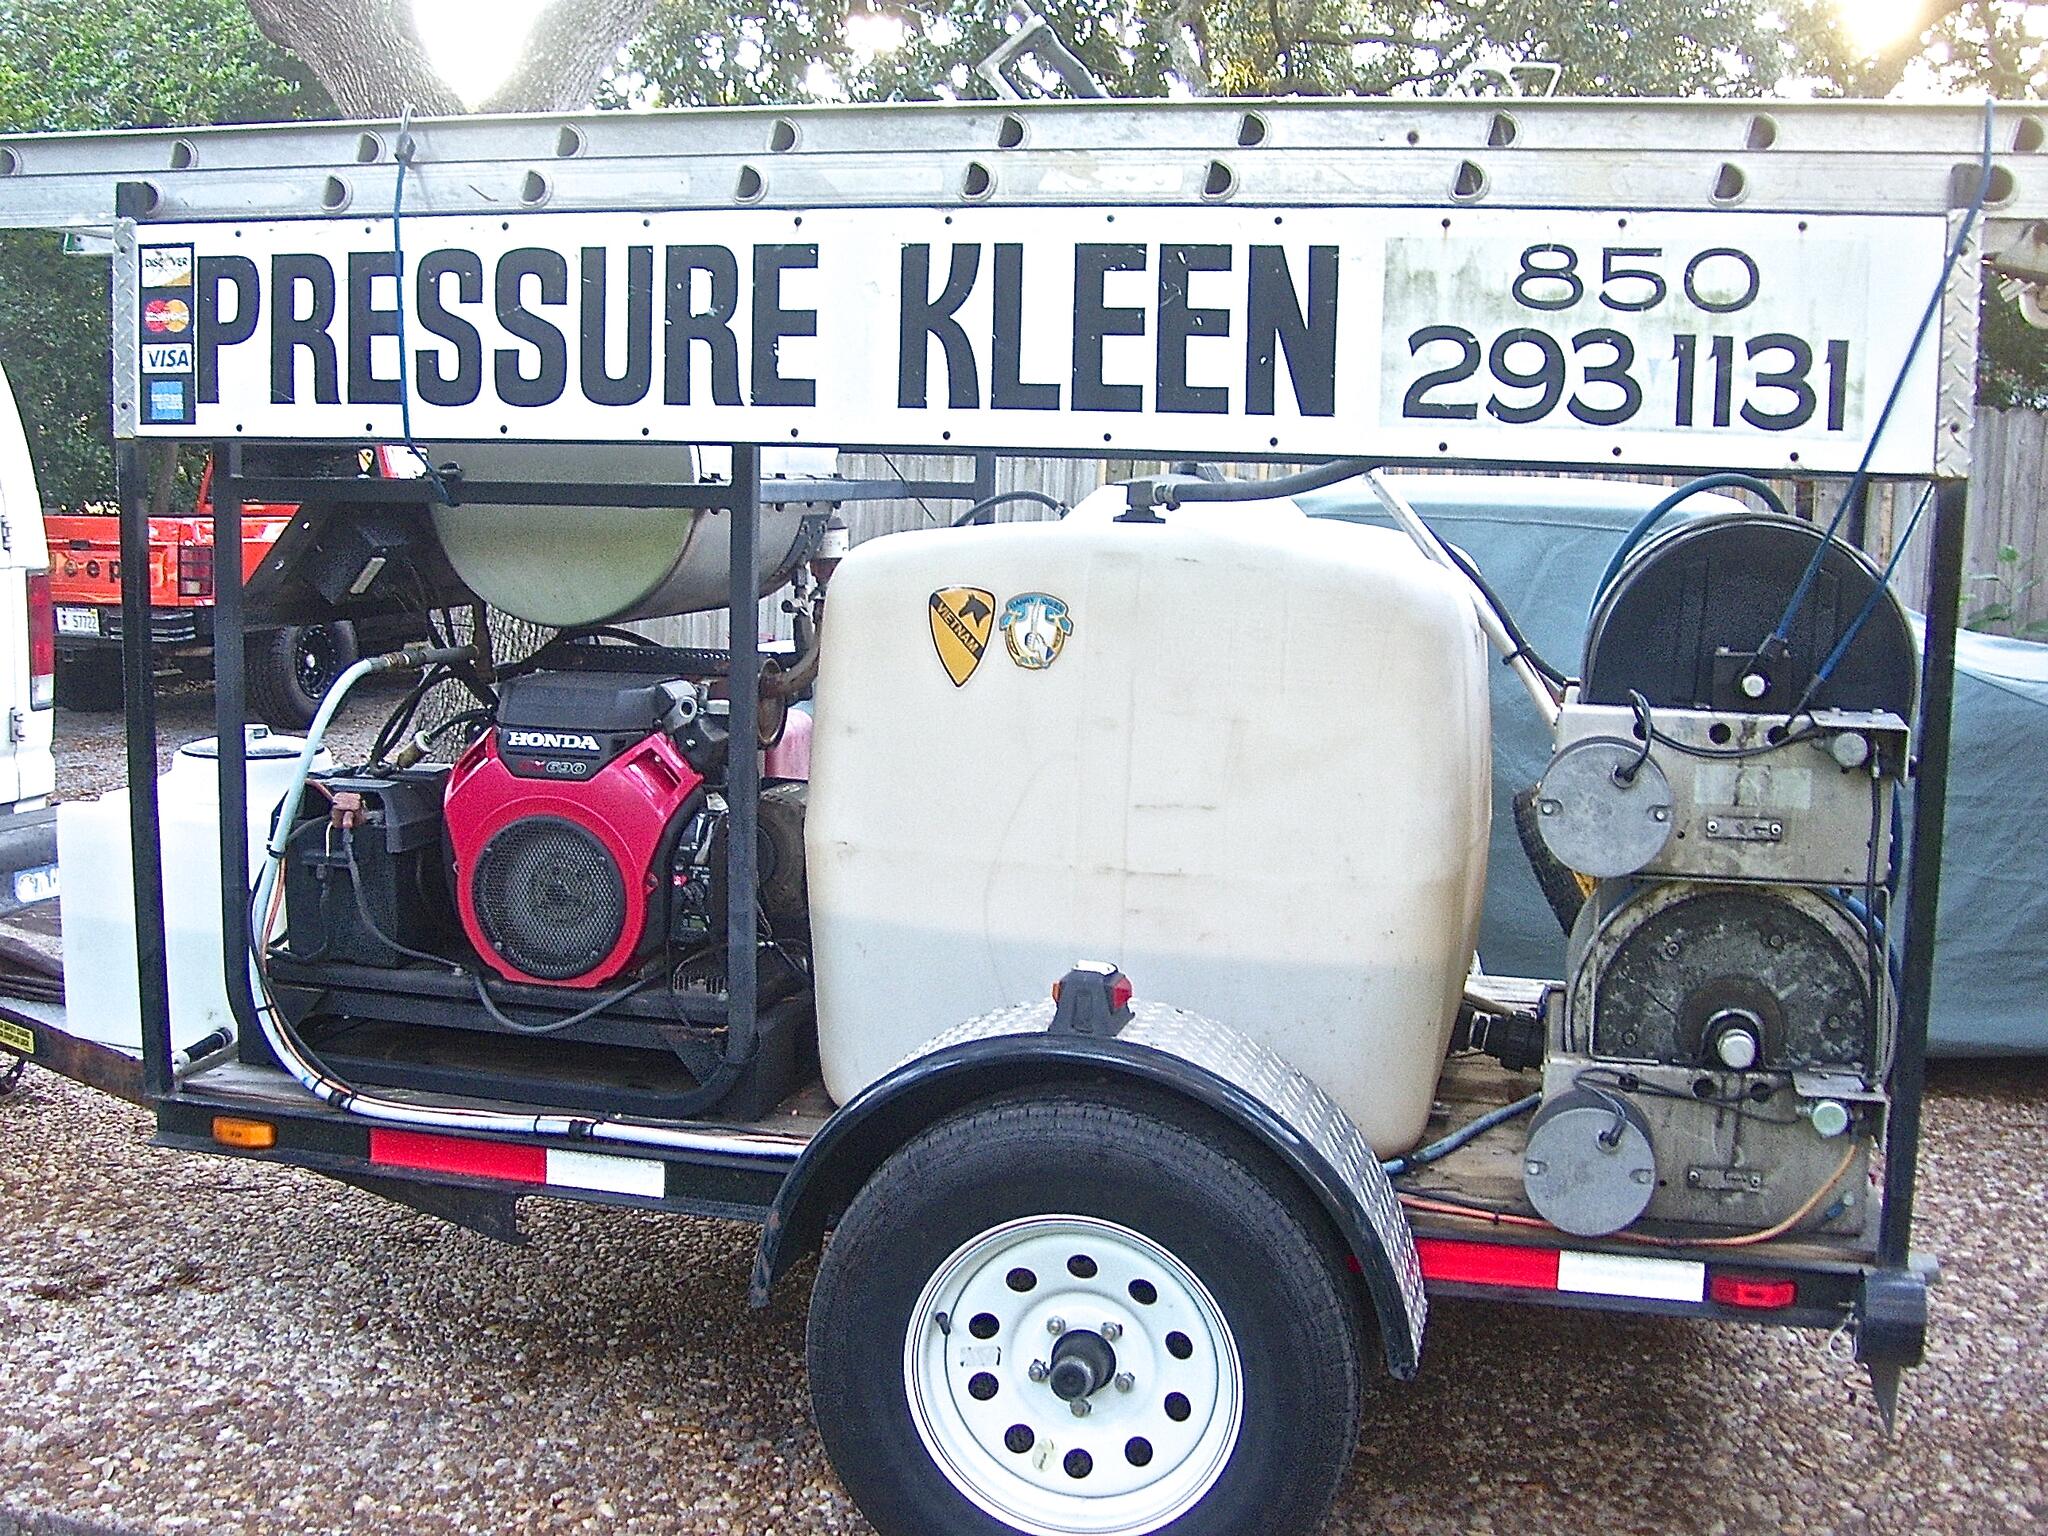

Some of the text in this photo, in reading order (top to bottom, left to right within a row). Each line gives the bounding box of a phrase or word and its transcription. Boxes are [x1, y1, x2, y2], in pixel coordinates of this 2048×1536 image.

[145, 256, 188, 268] DISCVER
[1512, 243, 1760, 314] 850
[197, 243, 1340, 417] PRESSURE KLEEN
[147, 349, 189, 367] VISA
[1402, 325, 1850, 432] 293 1131
[936, 602, 980, 654] VIETNAM
[507, 731, 601, 751] HONDA
